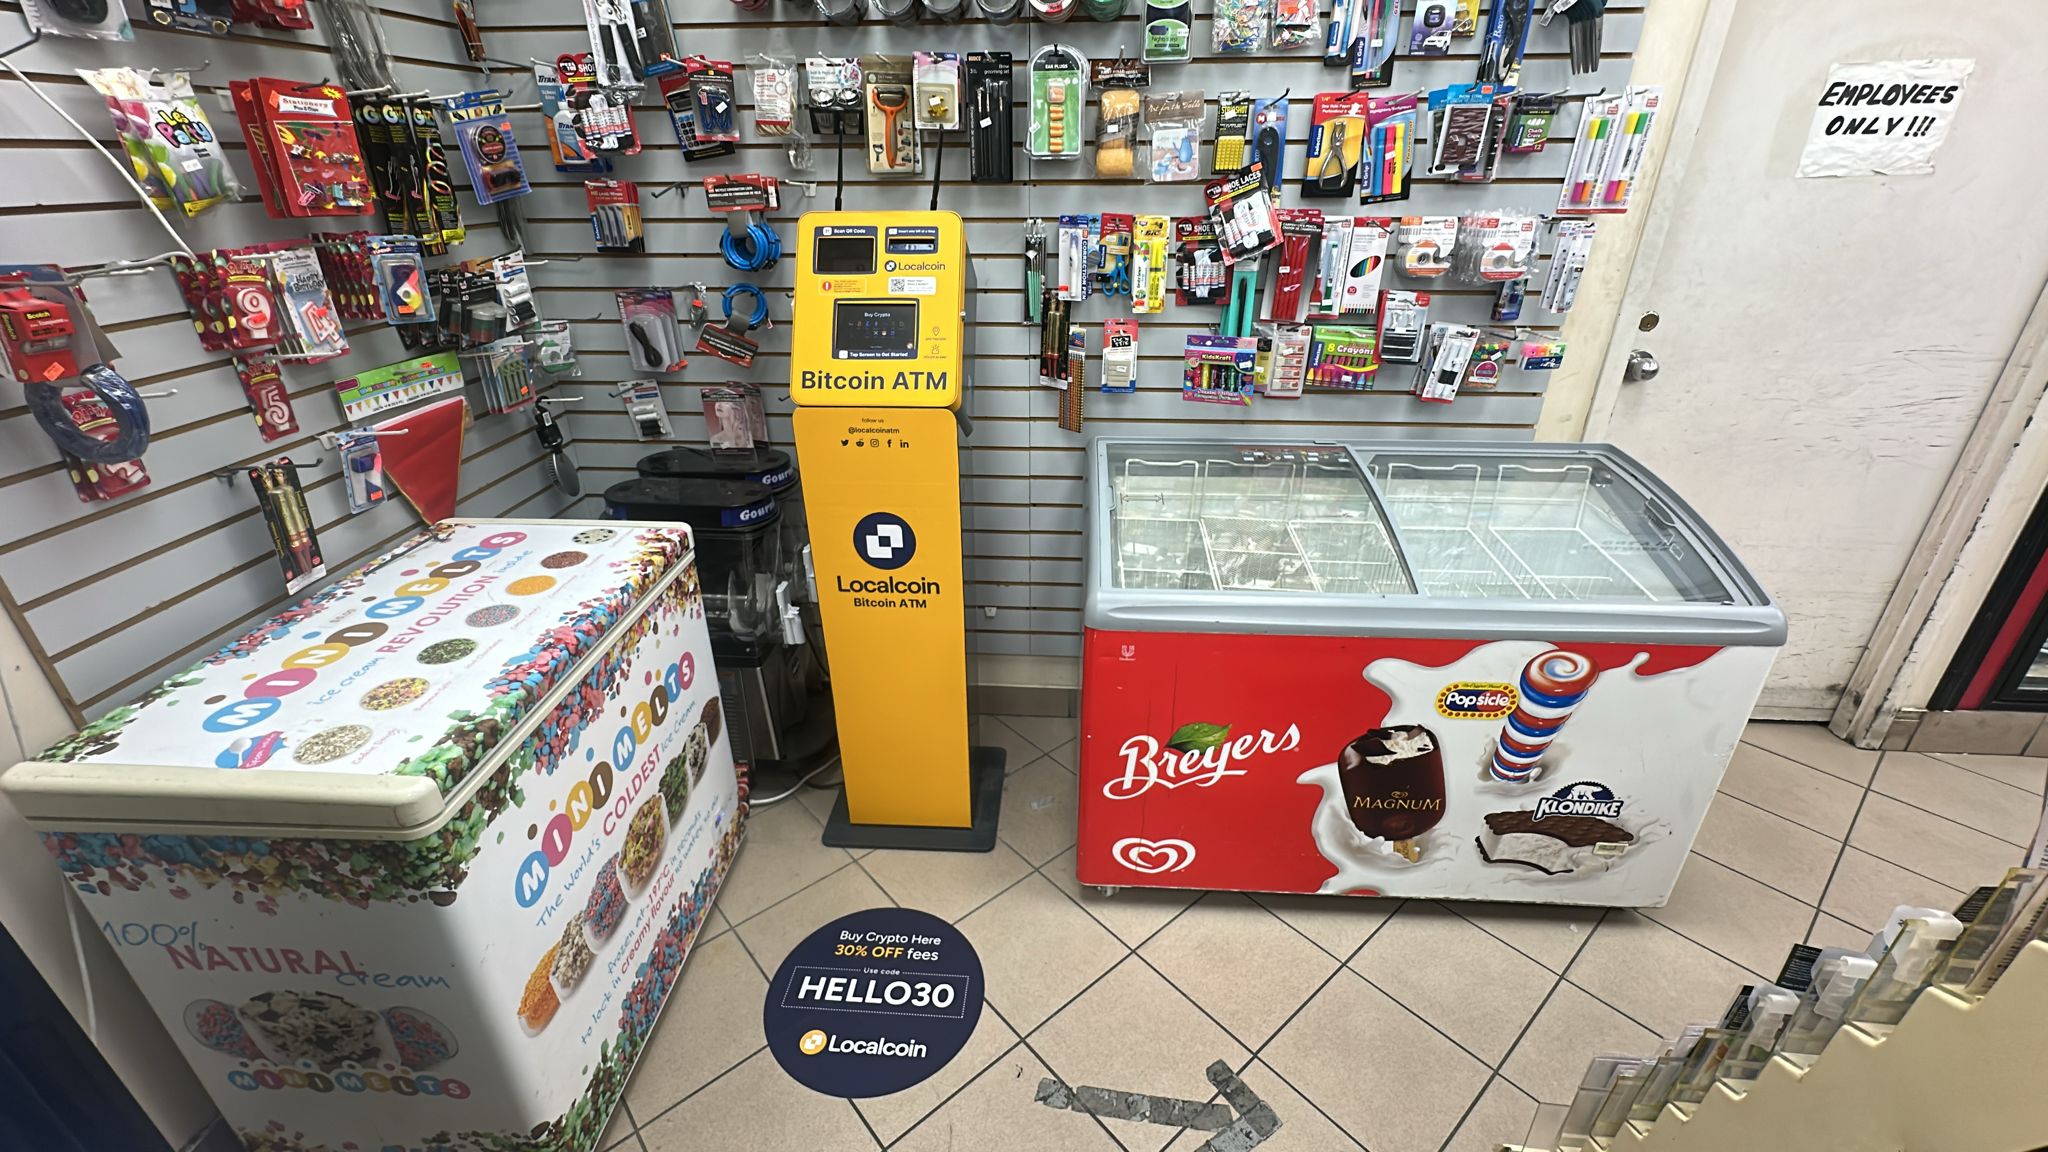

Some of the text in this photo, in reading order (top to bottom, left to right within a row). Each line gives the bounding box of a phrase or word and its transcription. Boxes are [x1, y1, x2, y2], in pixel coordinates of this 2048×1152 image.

[1818, 81, 1959, 107] EMPLOYEES
[1159, 103, 1170, 115] for
[155, 120, 213, 148] Party
[1240, 170, 1262, 183] LACES
[1193, 224, 1211, 233] SHOE
[898, 261, 946, 271] Localcoin
[293, 280, 325, 292] BIRTHDAY
[295, 272, 319, 283] HAPPY
[26, 311, 51, 320] Scotch
[1327, 343, 1374, 355] 8 Crayons
[801, 370, 947, 390] Bitcoin ATM
[847, 426, 900, 436] @localcoinatm
[836, 575, 941, 595] Localcoin
[853, 597, 927, 609] Bitcoin ATM
[376, 575, 499, 653] REVOLUTION
[208, 534, 520, 729] MINI MELTS
[1445, 691, 1509, 708] Popsicle
[1103, 723, 1300, 800] Breyers
[518, 657, 692, 904] MINI MELTS
[1352, 795, 1442, 811] MAGNUM
[1535, 798, 1622, 821] KLONDIKE
[536, 895, 565, 928] The
[563, 837, 602, 891] World's
[602, 744, 663, 837] COLDEST
[103, 921, 208, 954] 100%
[839, 930, 942, 945] Buy Crypto Here
[164, 943, 367, 978] NATURAL
[606, 928, 637, 978] frozen
[834, 944, 940, 961] 30% OFF fees
[336, 969, 451, 990] cream
[863, 967, 901, 976] Use code
[580, 1025, 593, 1046] to
[591, 990, 614, 1024] lock
[620, 920, 652, 976] creamy
[797, 974, 955, 1009] HELLO30
[828, 1034, 927, 1058] Localcoin
[231, 1071, 466, 1097] MINI MELTS
